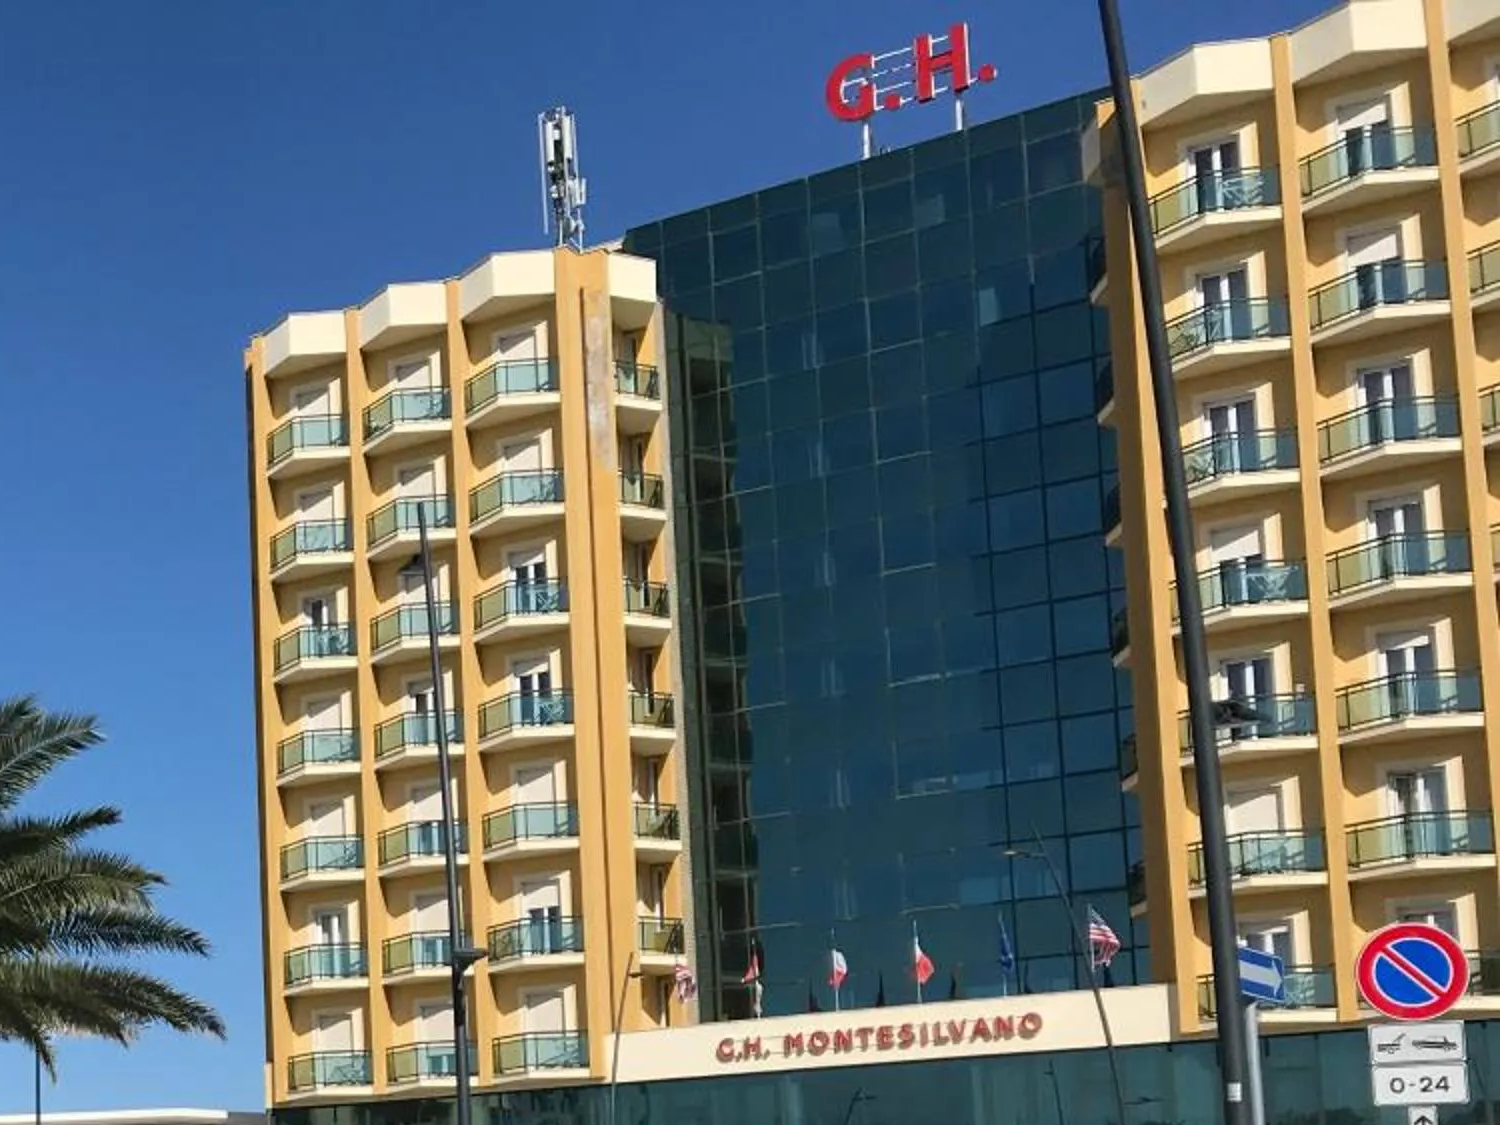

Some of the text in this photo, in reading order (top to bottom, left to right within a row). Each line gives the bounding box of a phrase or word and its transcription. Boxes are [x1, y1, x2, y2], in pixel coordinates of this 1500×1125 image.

[825, 21, 998, 122] G.H.
[782, 1011, 1043, 1058] MONTESILVANO
[1389, 1075, 1451, 1095] 0-24
